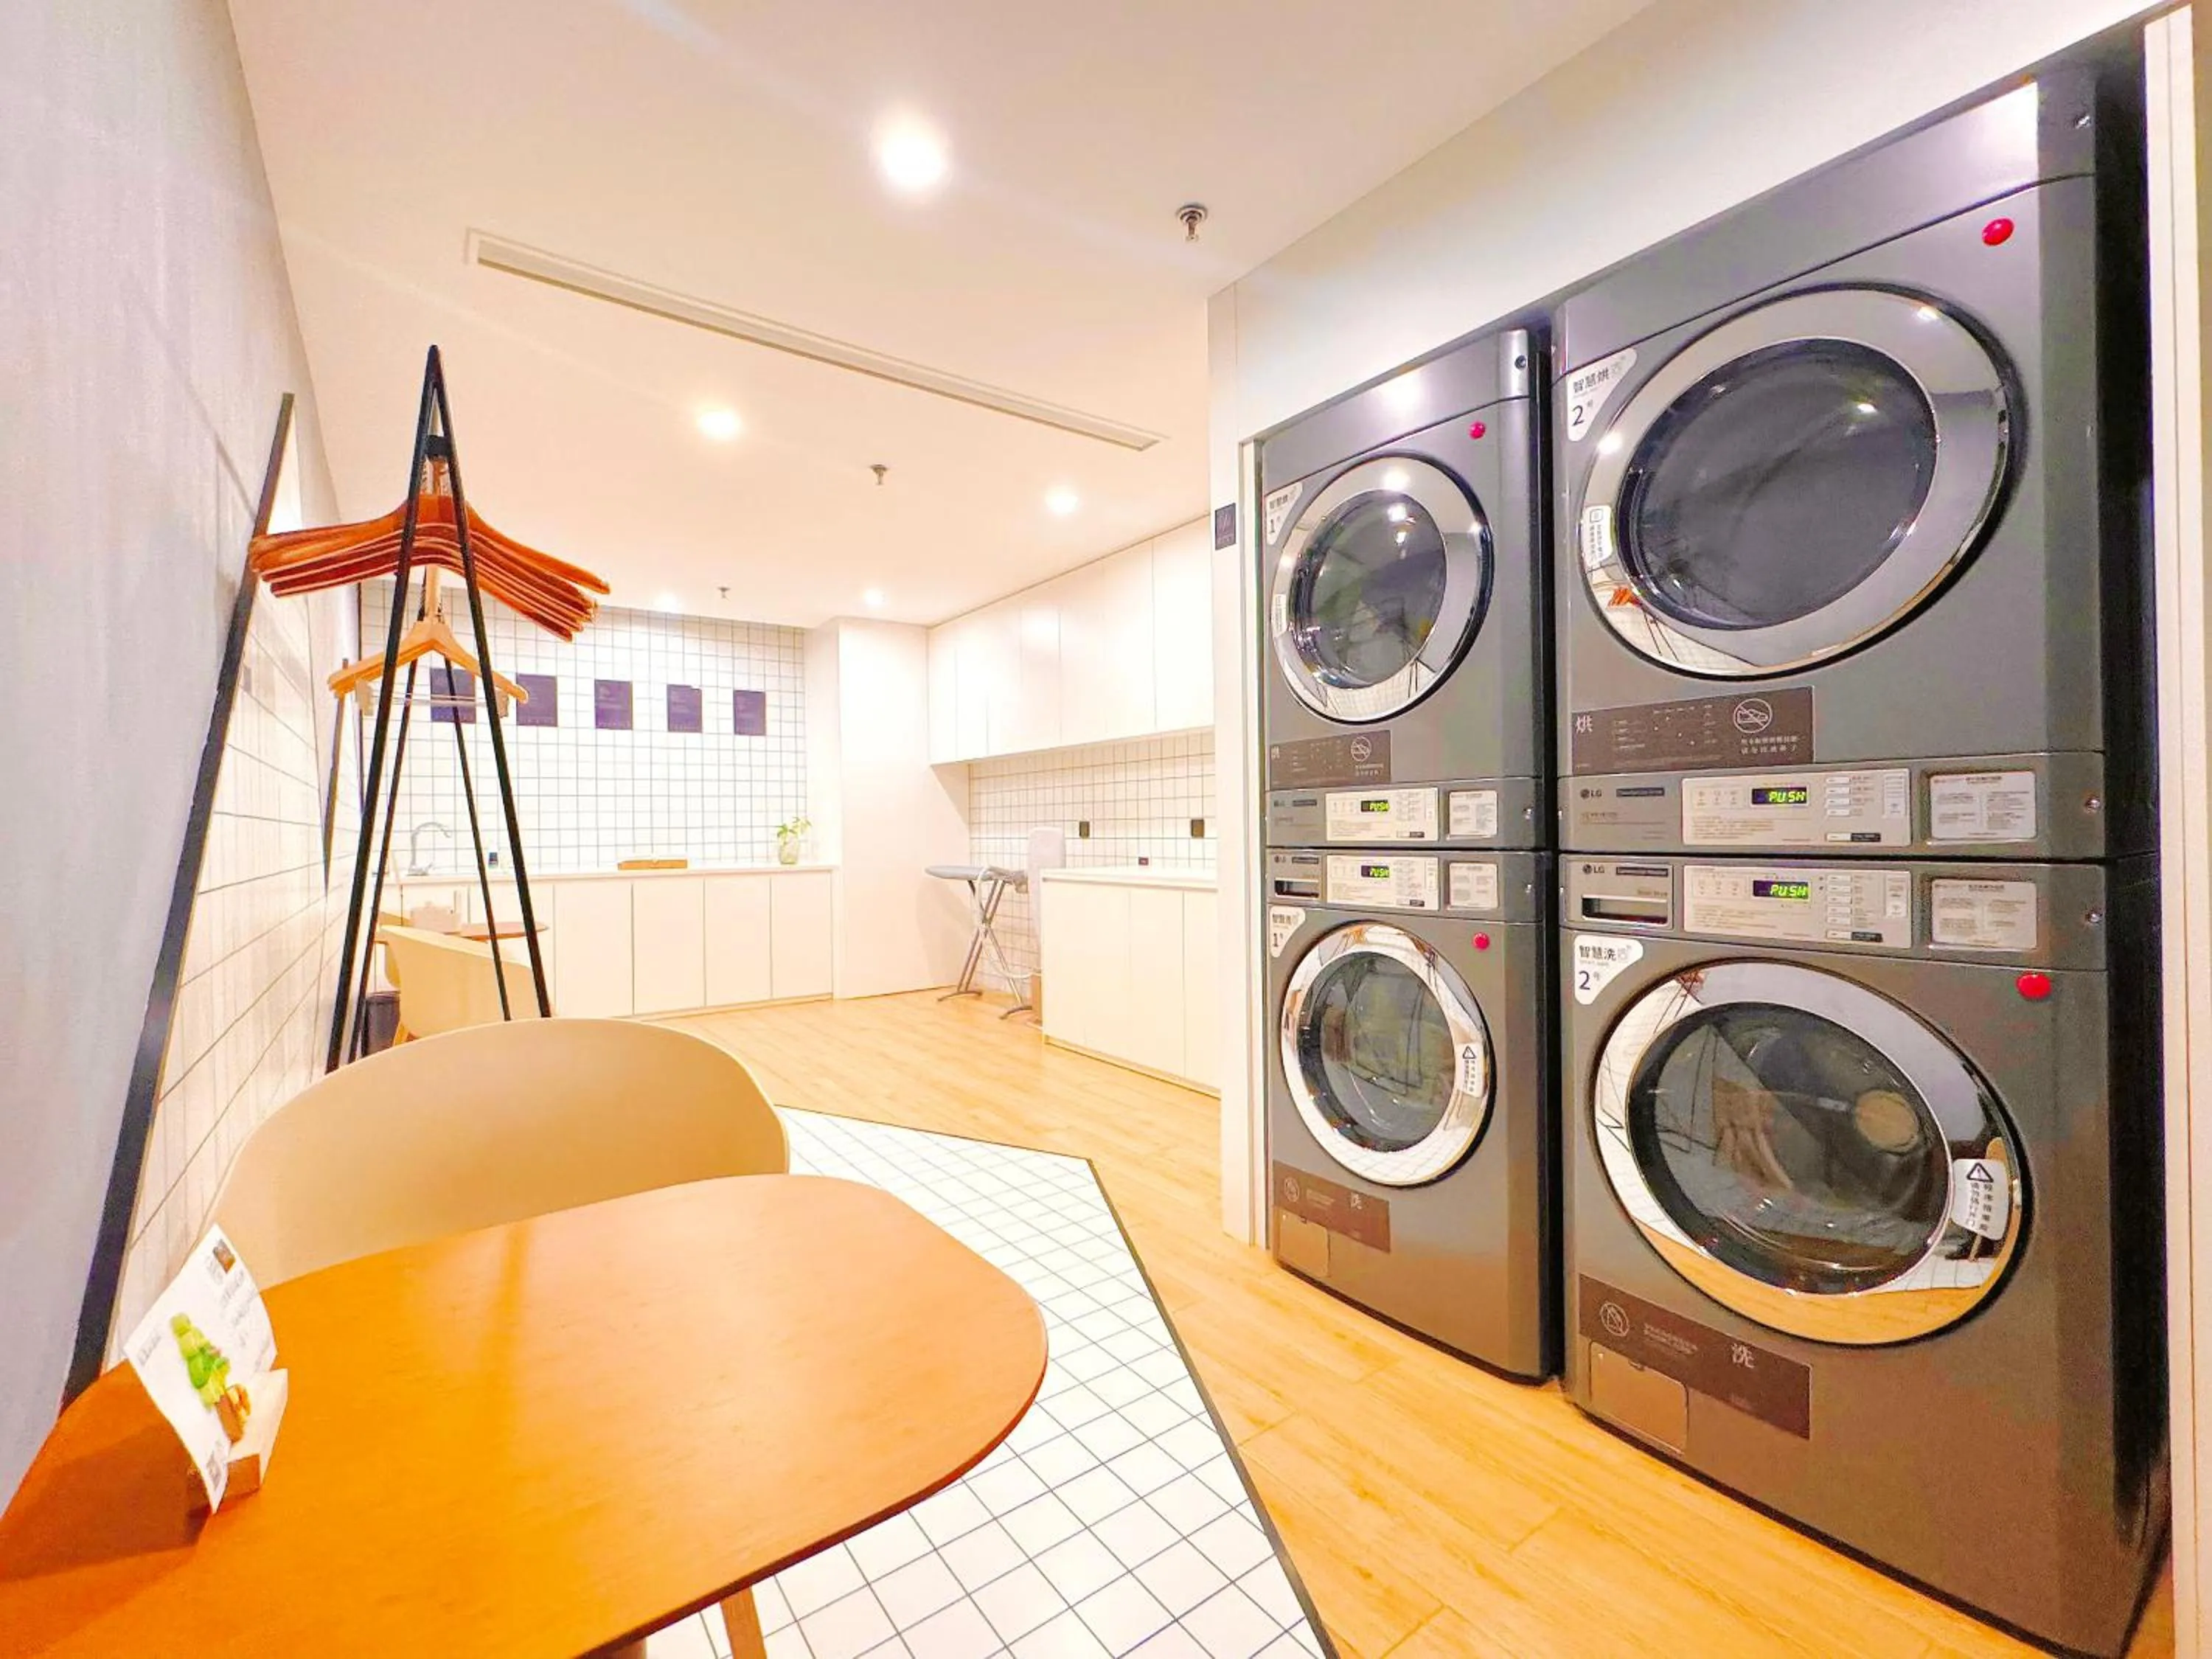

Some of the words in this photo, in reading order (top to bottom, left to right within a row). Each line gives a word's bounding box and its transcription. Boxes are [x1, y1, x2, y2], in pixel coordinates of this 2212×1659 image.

[1571, 404, 1585, 427] 2
[1769, 790, 1806, 803] PUSH
[1770, 884, 1807, 897] PUSH
[1579, 970, 1590, 990] 2
[1730, 1342, 1755, 1369] 洗
